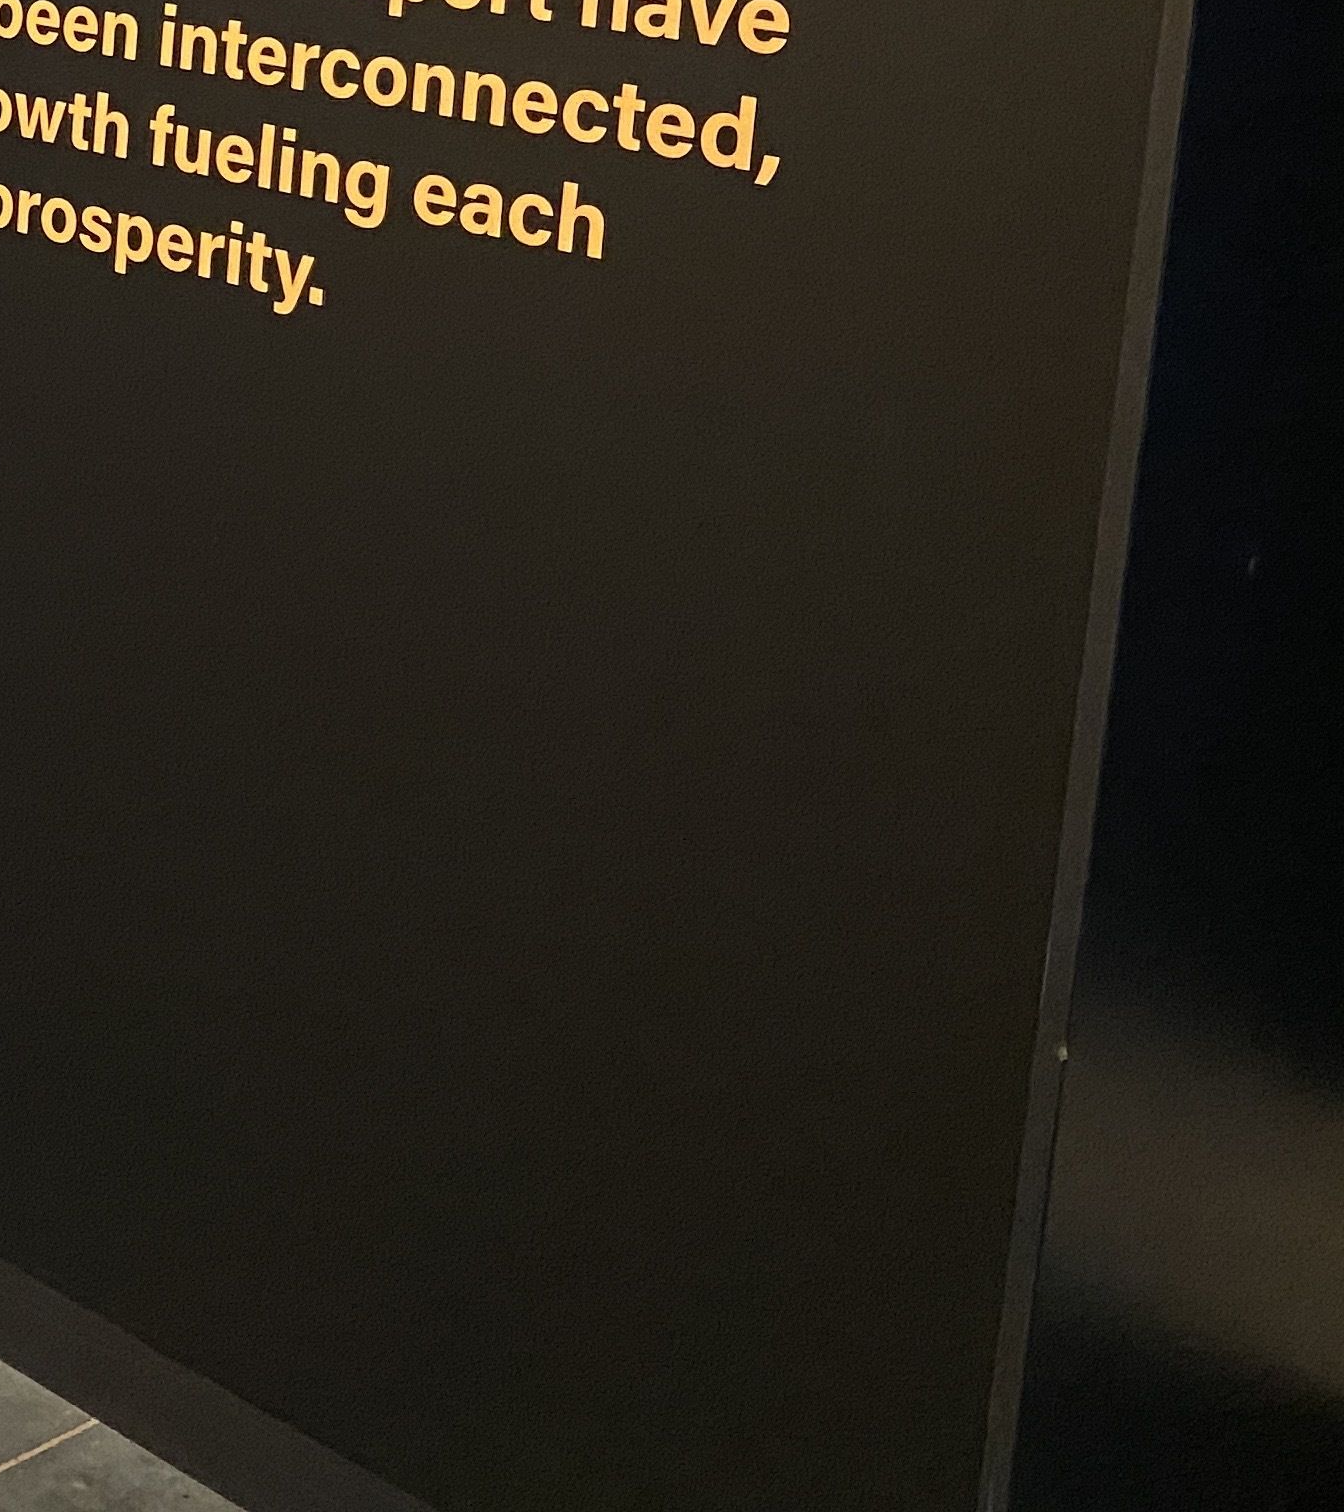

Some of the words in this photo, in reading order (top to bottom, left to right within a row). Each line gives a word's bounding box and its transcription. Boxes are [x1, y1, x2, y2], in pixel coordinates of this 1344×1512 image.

[159, 2, 781, 186] interconnected,
[149, 103, 390, 229] fueling
[413, 174, 605, 260] each
